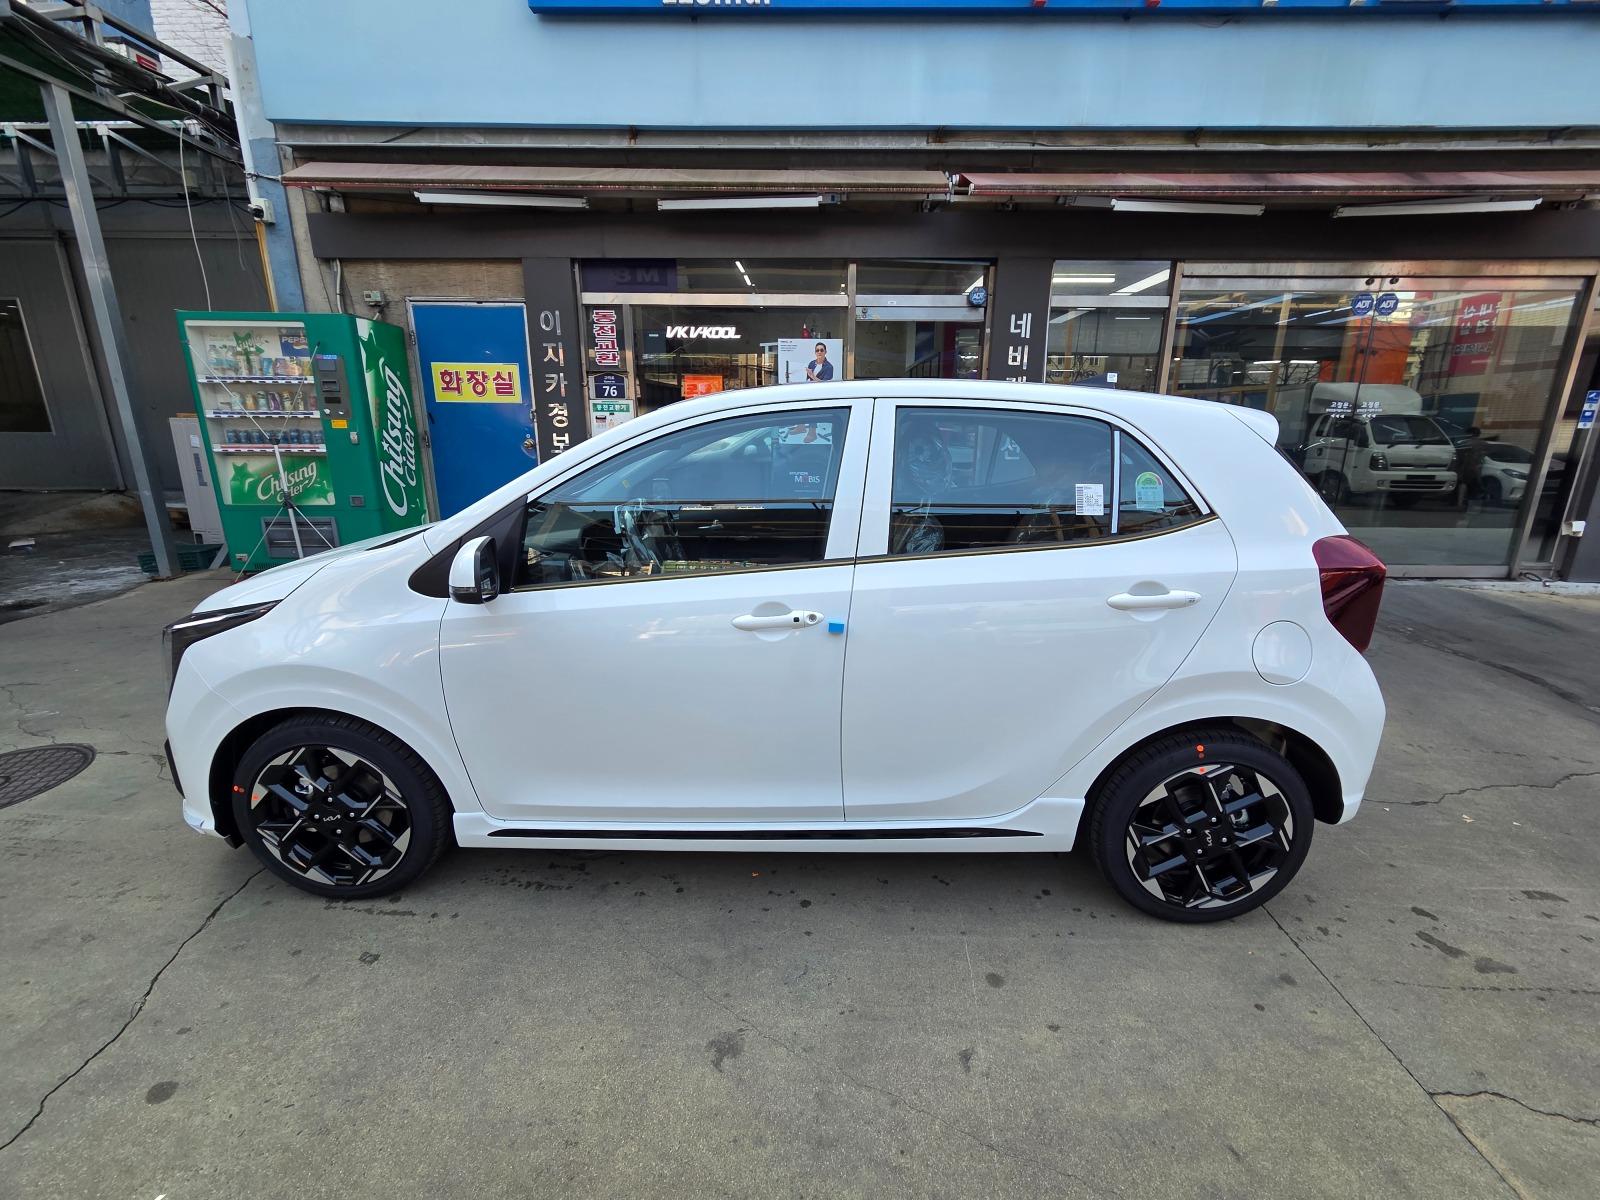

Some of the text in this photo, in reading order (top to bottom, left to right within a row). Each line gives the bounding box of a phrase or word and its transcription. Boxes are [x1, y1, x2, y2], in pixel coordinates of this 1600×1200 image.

[1355, 300, 1372, 309] ADT
[1380, 300, 1397, 309] ADT
[592, 310, 619, 365] 동전교환
[439, 369, 517, 398] 화장실
[602, 385, 618, 397] 76
[380, 365, 413, 517] Chilsung
[402, 405, 417, 488] Cider
